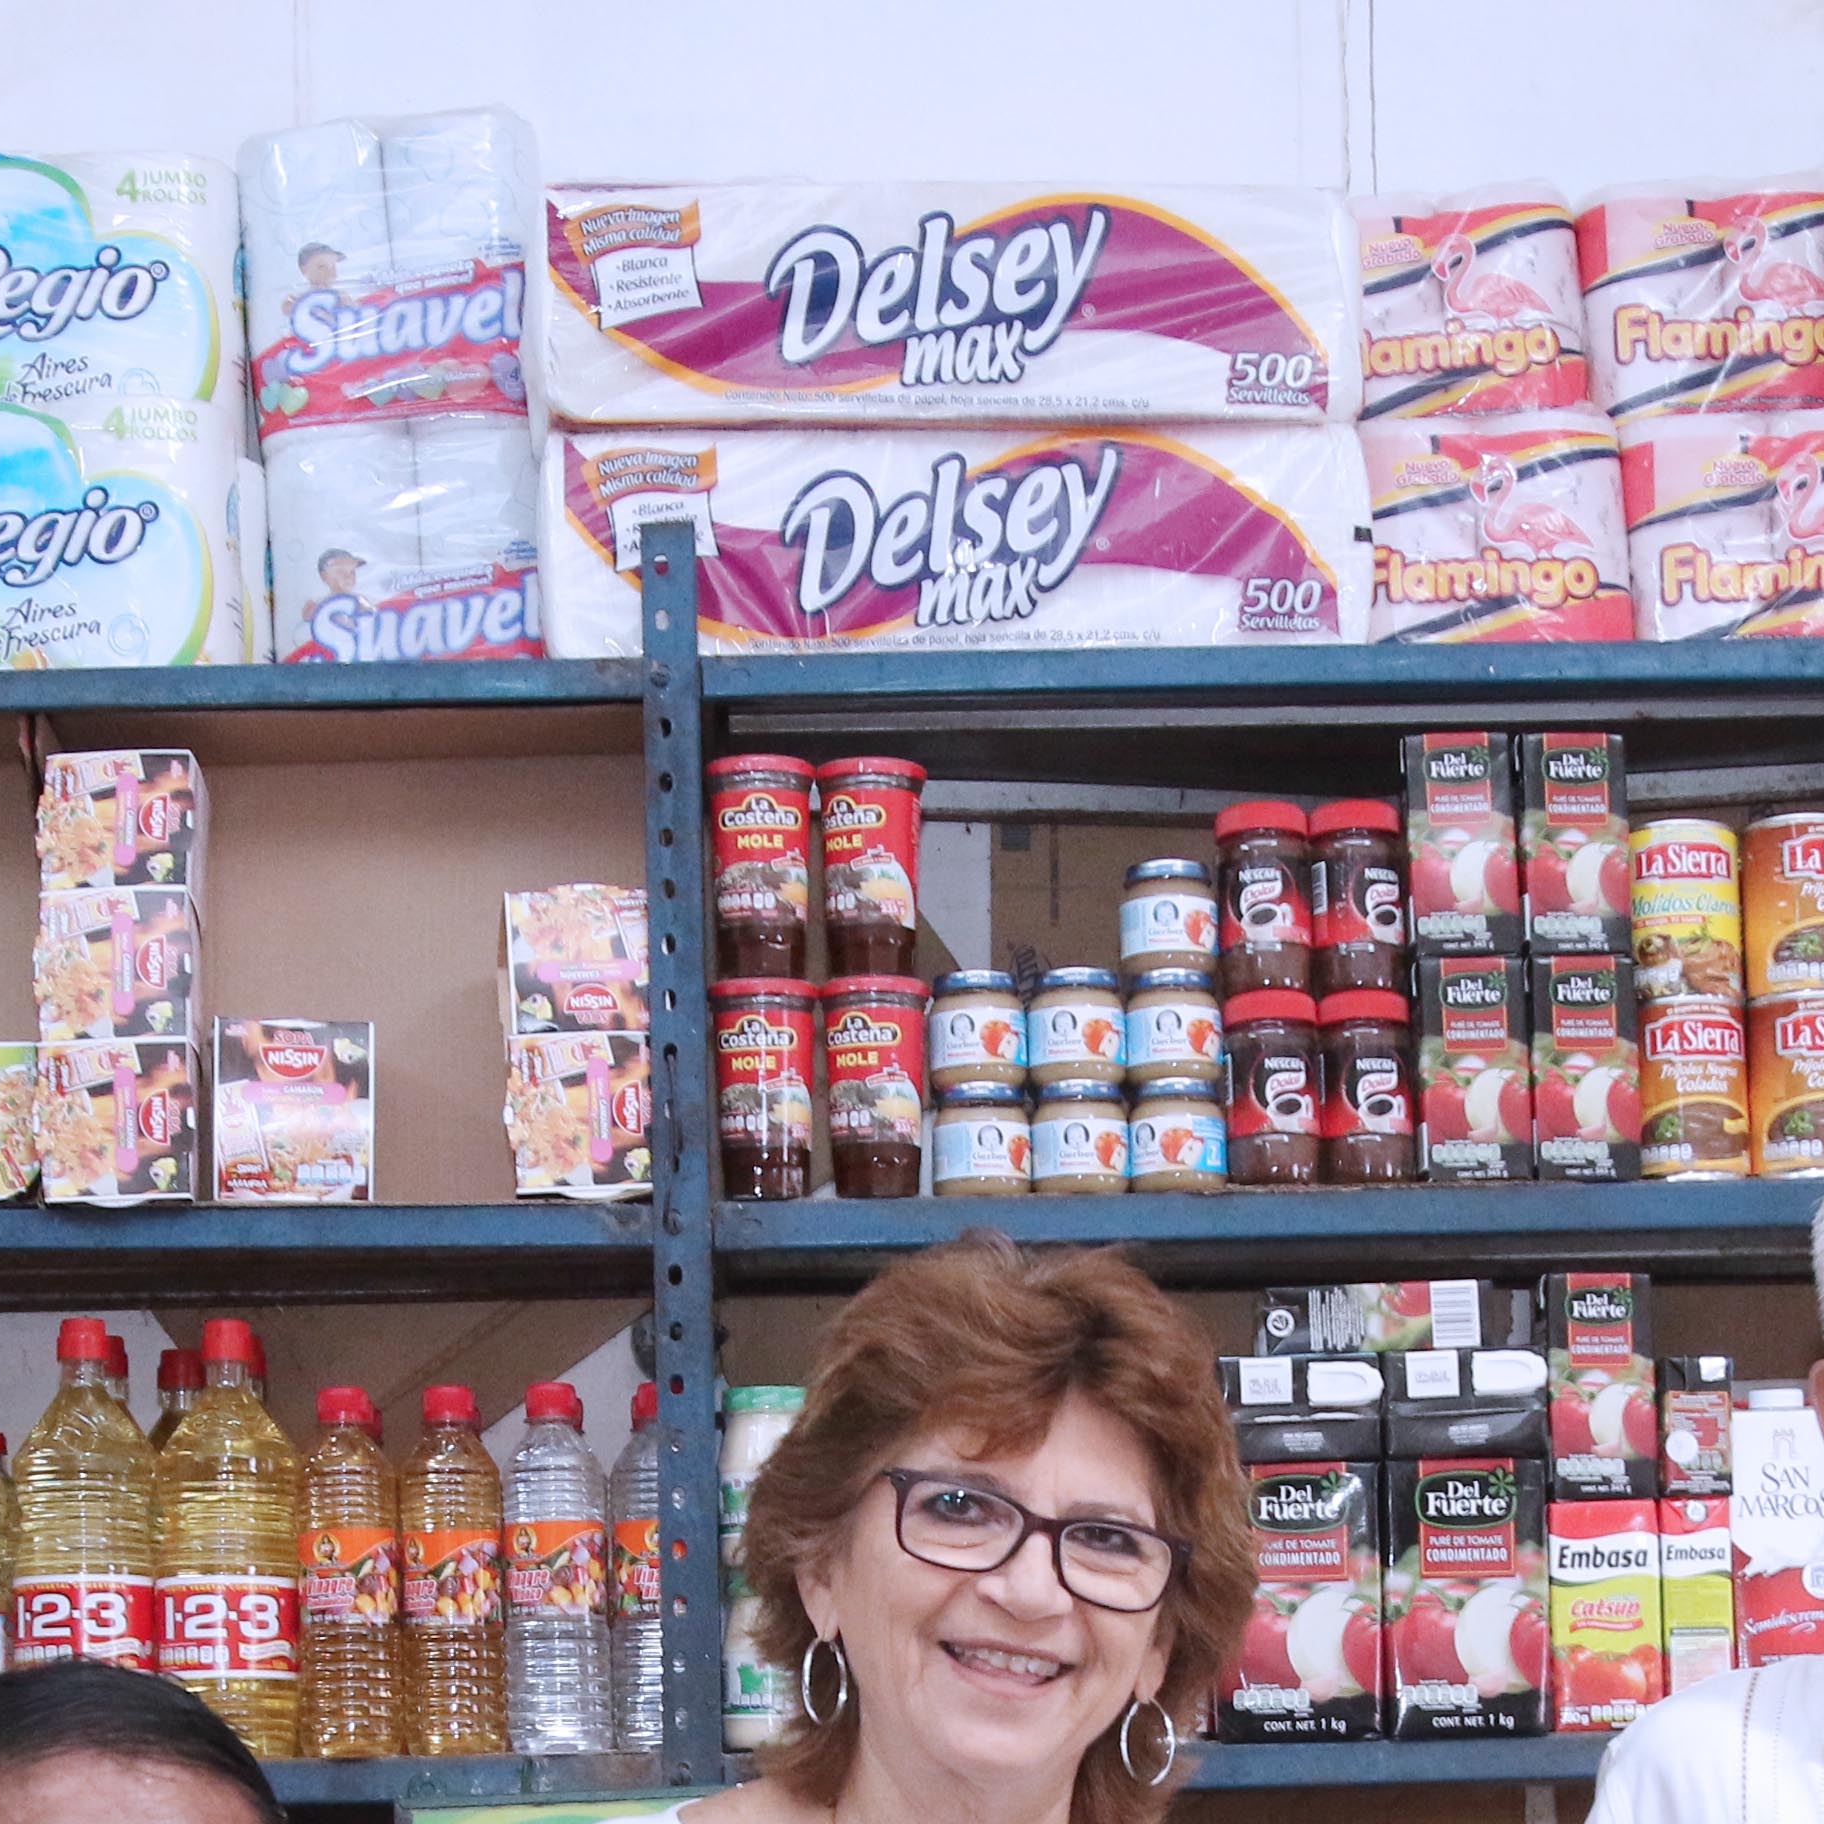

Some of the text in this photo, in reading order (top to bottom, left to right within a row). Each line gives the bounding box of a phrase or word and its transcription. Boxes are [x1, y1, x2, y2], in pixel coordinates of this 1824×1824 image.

[622, 256, 668, 272] Blanca
[615, 273, 682, 293] Resistente
[765, 201, 1111, 366] Delsey
[614, 288, 689, 312] Absorbente
[287, 263, 525, 375] Suavel
[898, 317, 1026, 387] max
[1362, 319, 1560, 378] lamingo
[1227, 351, 1315, 390] 500
[814, 392, 835, 402] 500
[897, 394, 912, 404] de
[1075, 397, 1099, 407] 21.2
[1227, 384, 1311, 406] Servilletas
[597, 452, 698, 476] Nueva imagen
[599, 468, 698, 498] Misma calidad
[781, 440, 1124, 615] Delsey
[915, 559, 1038, 631] max
[1241, 576, 1323, 615] 500
[4, 597, 78, 628] Aires
[311, 571, 541, 663] Suavel
[1239, 610, 1321, 633] Servilletas
[1, 618, 101, 656] Frescura
[1430, 761, 1485, 778] Fuerte
[1444, 753, 1466, 765] Del
[751, 798, 769, 813] La
[154, 800, 167, 839] NISSIN
[723, 809, 800, 827] Costeña
[736, 834, 784, 849] MOLE
[1640, 845, 1729, 878] La Sierra
[742, 1018, 760, 1033] La
[1655, 1020, 1741, 1053] La Sierra
[721, 1030, 795, 1047] Costeña
[267, 1050, 320, 1067] NISSIN
[731, 1055, 777, 1070] MOLE
[1761, 1463, 1810, 1492] SAN
[1447, 1480, 1480, 1500] Del
[1426, 1493, 1508, 1519] Fuerte
[1430, 1535, 1504, 1547] PURÉ DE TOMATE
[1426, 1548, 1508, 1562] CONDIMENTADO
[1558, 1545, 1648, 1569] Embasa
[1666, 1545, 1726, 1562] Embasa
[17, 1593, 129, 1639] 1-2-3
[166, 1594, 280, 1640] 1-2-3
[1432, 1716, 1461, 1729] CONT.
[1465, 1715, 1485, 1728] NET.
[1498, 1712, 1515, 1730] kg
